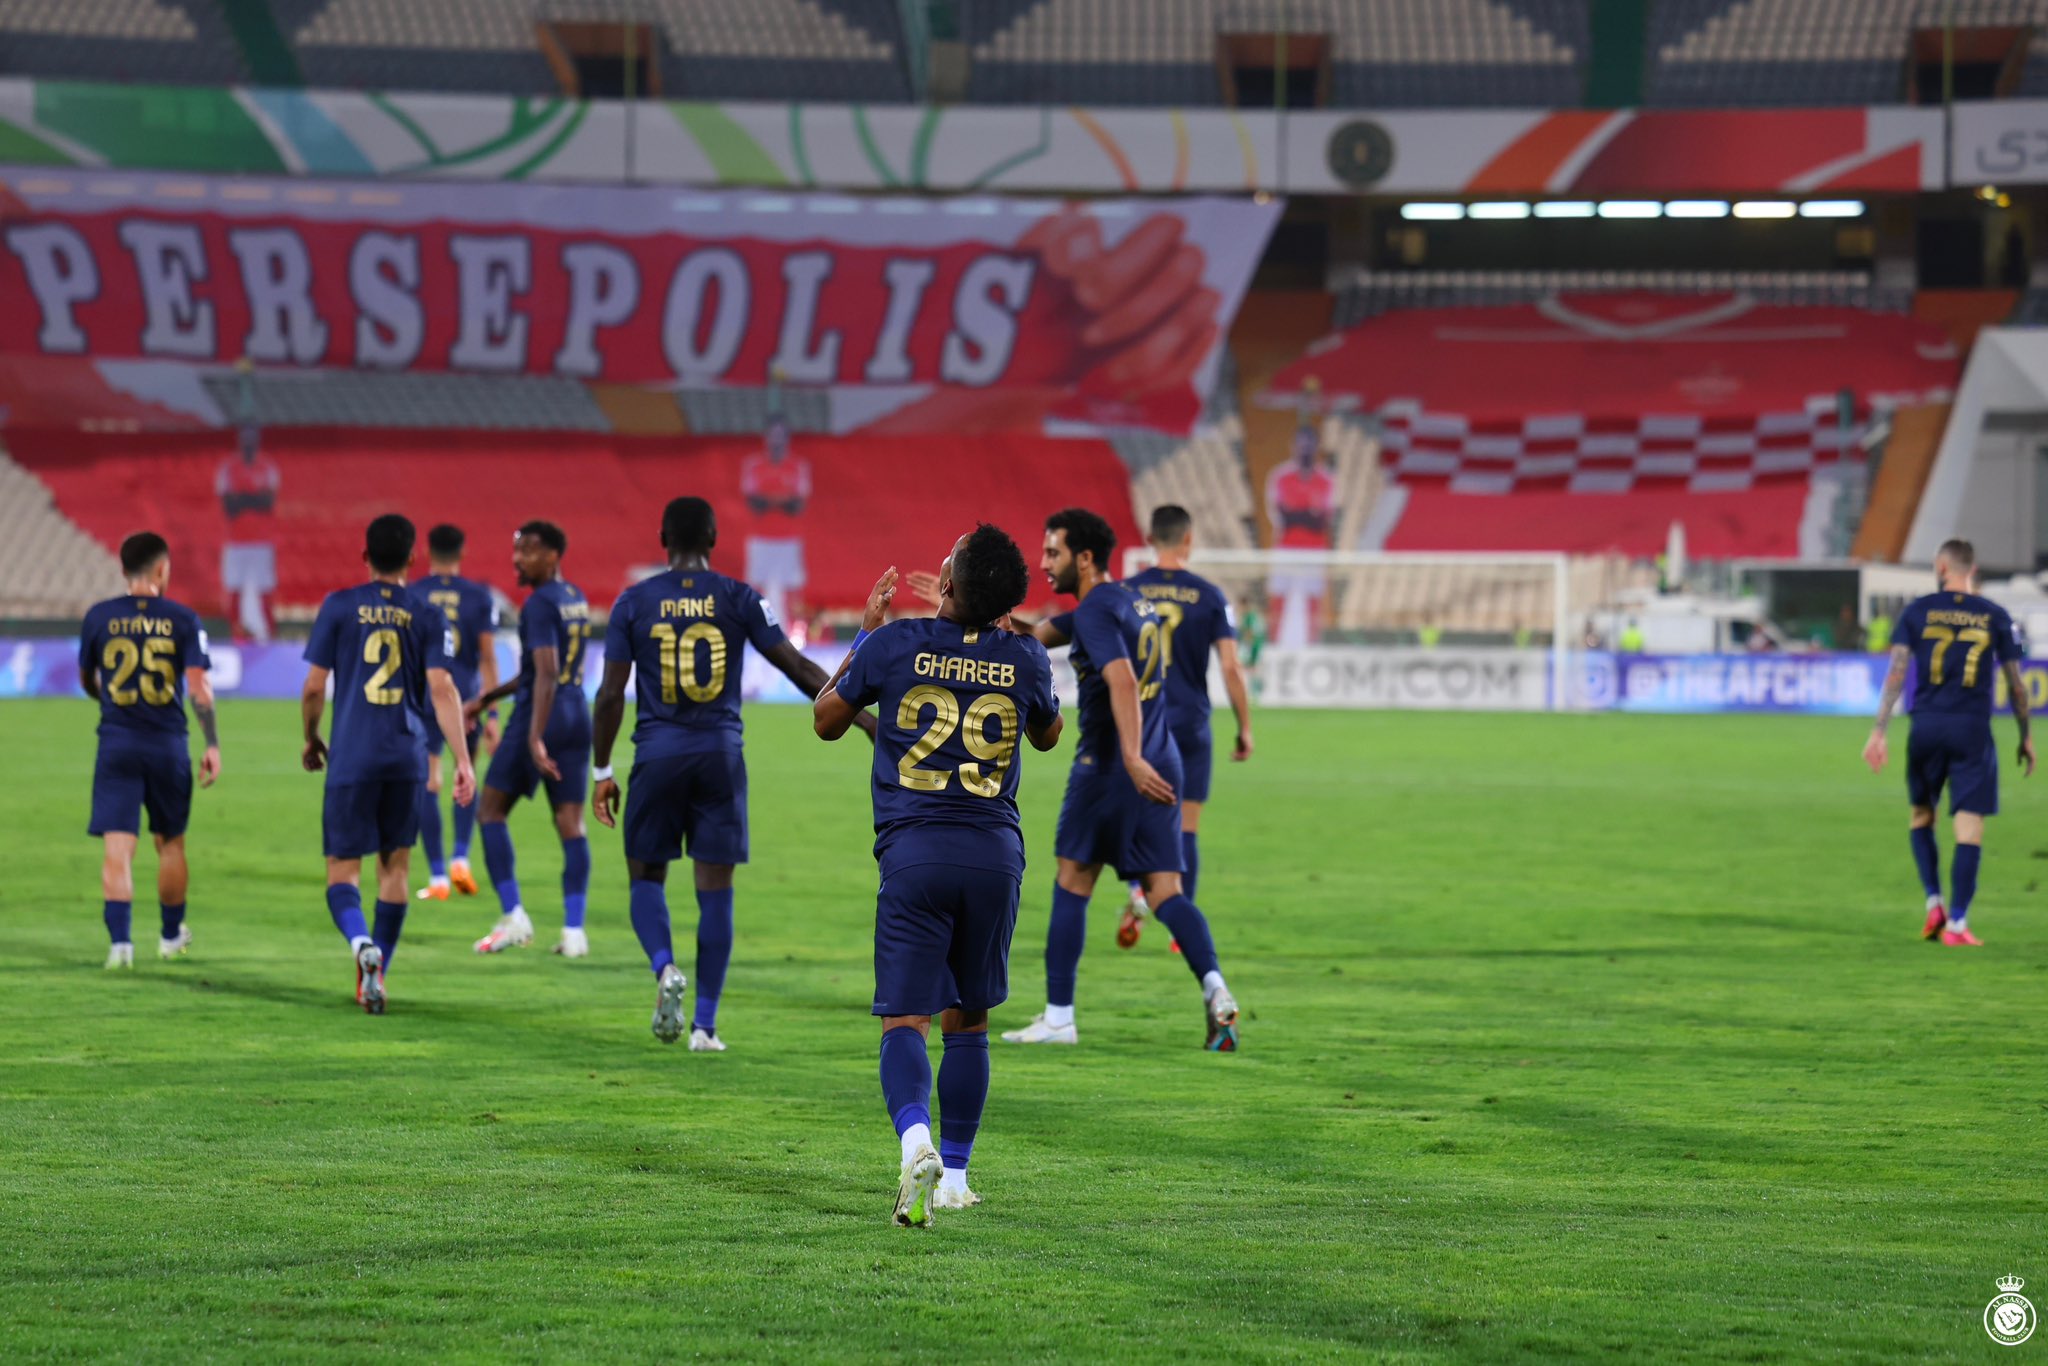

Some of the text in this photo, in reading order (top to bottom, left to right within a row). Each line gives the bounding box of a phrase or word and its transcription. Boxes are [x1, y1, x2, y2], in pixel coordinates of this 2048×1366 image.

[4, 218, 1036, 386] PERSEPOLIS
[108, 614, 173, 636] OTÁVIO
[660, 595, 715, 618] MANÉ
[103, 637, 176, 706] 25
[363, 629, 403, 705] 2
[650, 622, 726, 704] 10
[914, 652, 1015, 687] GHAREEB
[1921, 626, 1990, 687] 77
[896, 684, 1018, 798] 29
